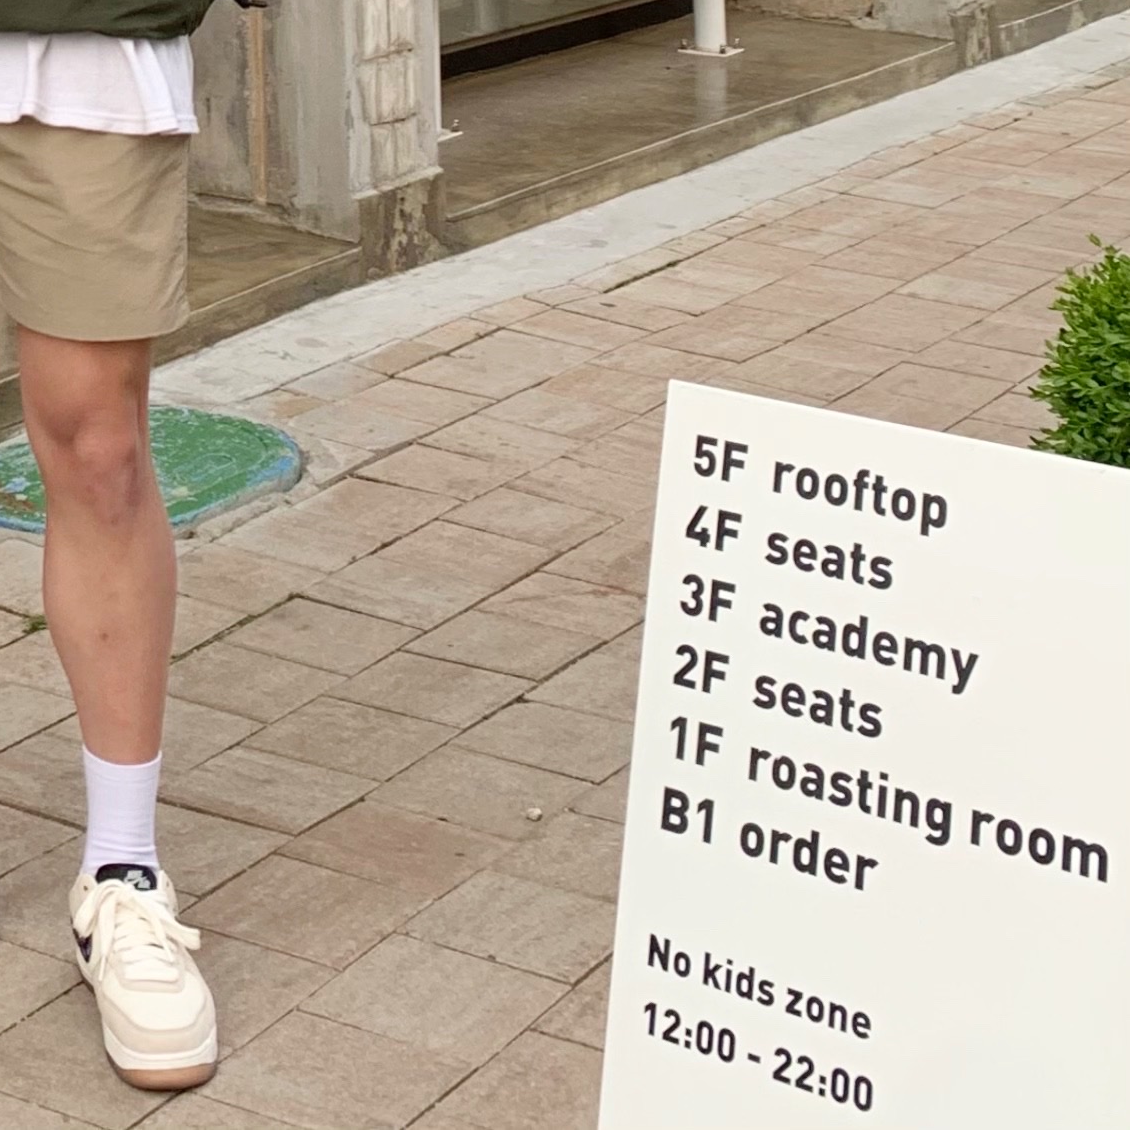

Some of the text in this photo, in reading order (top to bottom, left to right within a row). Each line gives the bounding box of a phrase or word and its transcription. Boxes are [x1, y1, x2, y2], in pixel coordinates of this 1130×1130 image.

[693, 434, 947, 537] 5F rooftop
[685, 505, 893, 590] 4F seats
[680, 574, 979, 695] 3F academy
[673, 644, 882, 738] 2F seats
[660, 786, 879, 891] B1 order
[670, 716, 1108, 883] 1F roasting room
[647, 933, 873, 1039] No kids zone
[643, 1002, 873, 1112] 12:00 - 22:00
